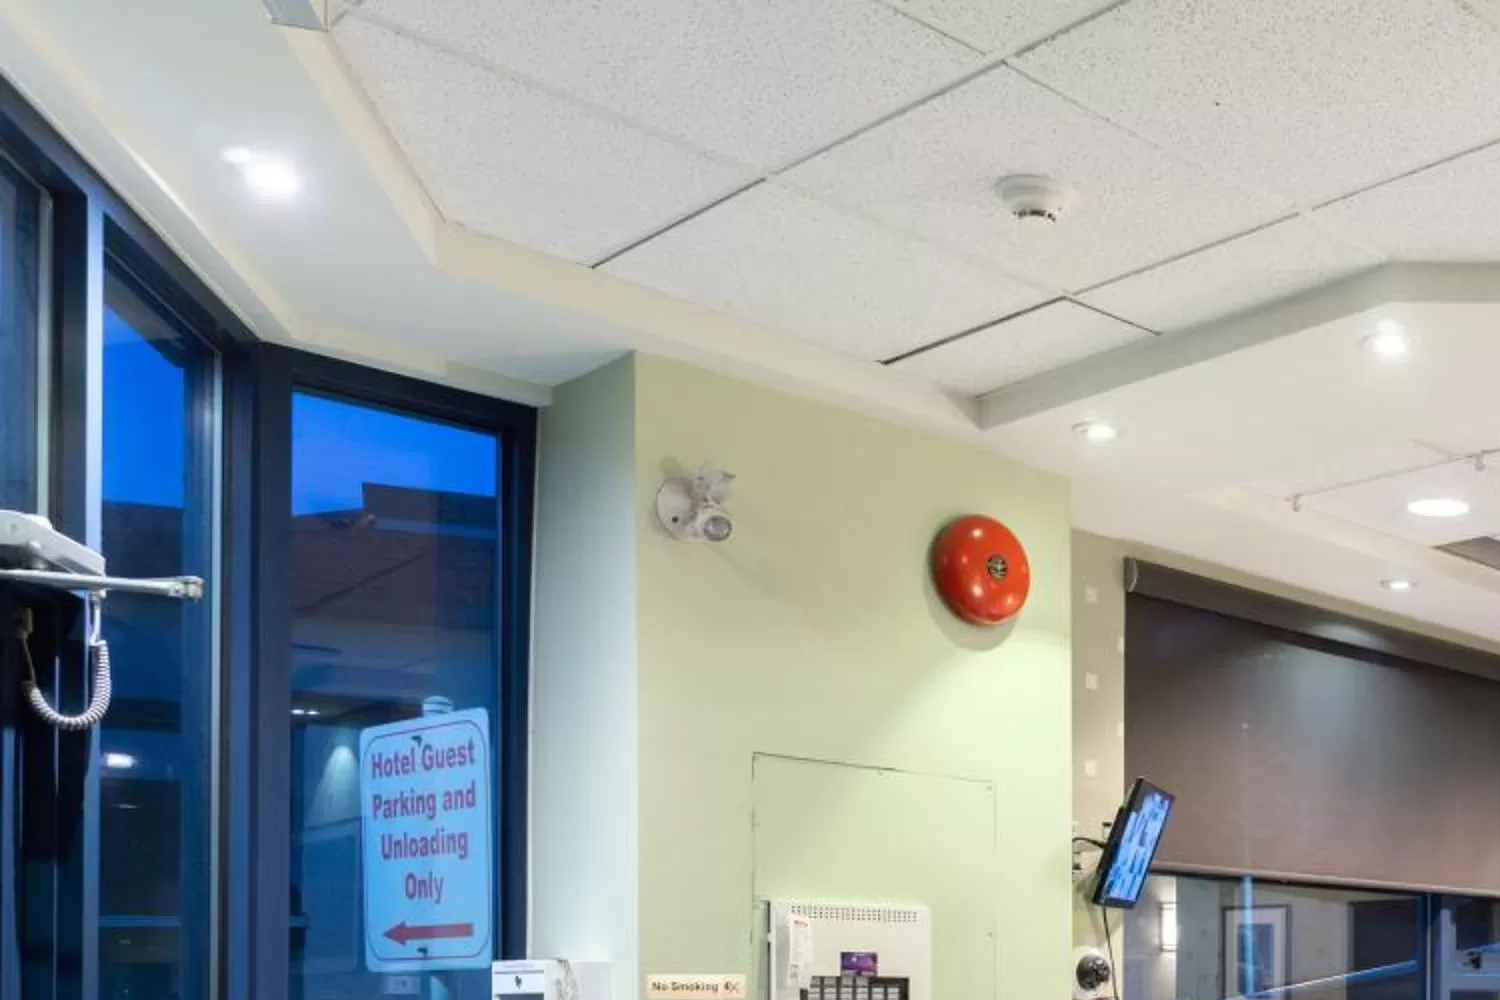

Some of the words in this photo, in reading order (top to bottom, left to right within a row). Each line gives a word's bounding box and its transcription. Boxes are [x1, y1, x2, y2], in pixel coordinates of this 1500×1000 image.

[371, 747, 415, 780] Hotel
[421, 738, 475, 772] Guest
[372, 788, 436, 820] Parking
[443, 780, 476, 810] and
[381, 828, 468, 860] Unloading
[405, 871, 444, 904] Only
[652, 981, 669, 991] No
[671, 981, 719, 994] Smoking
